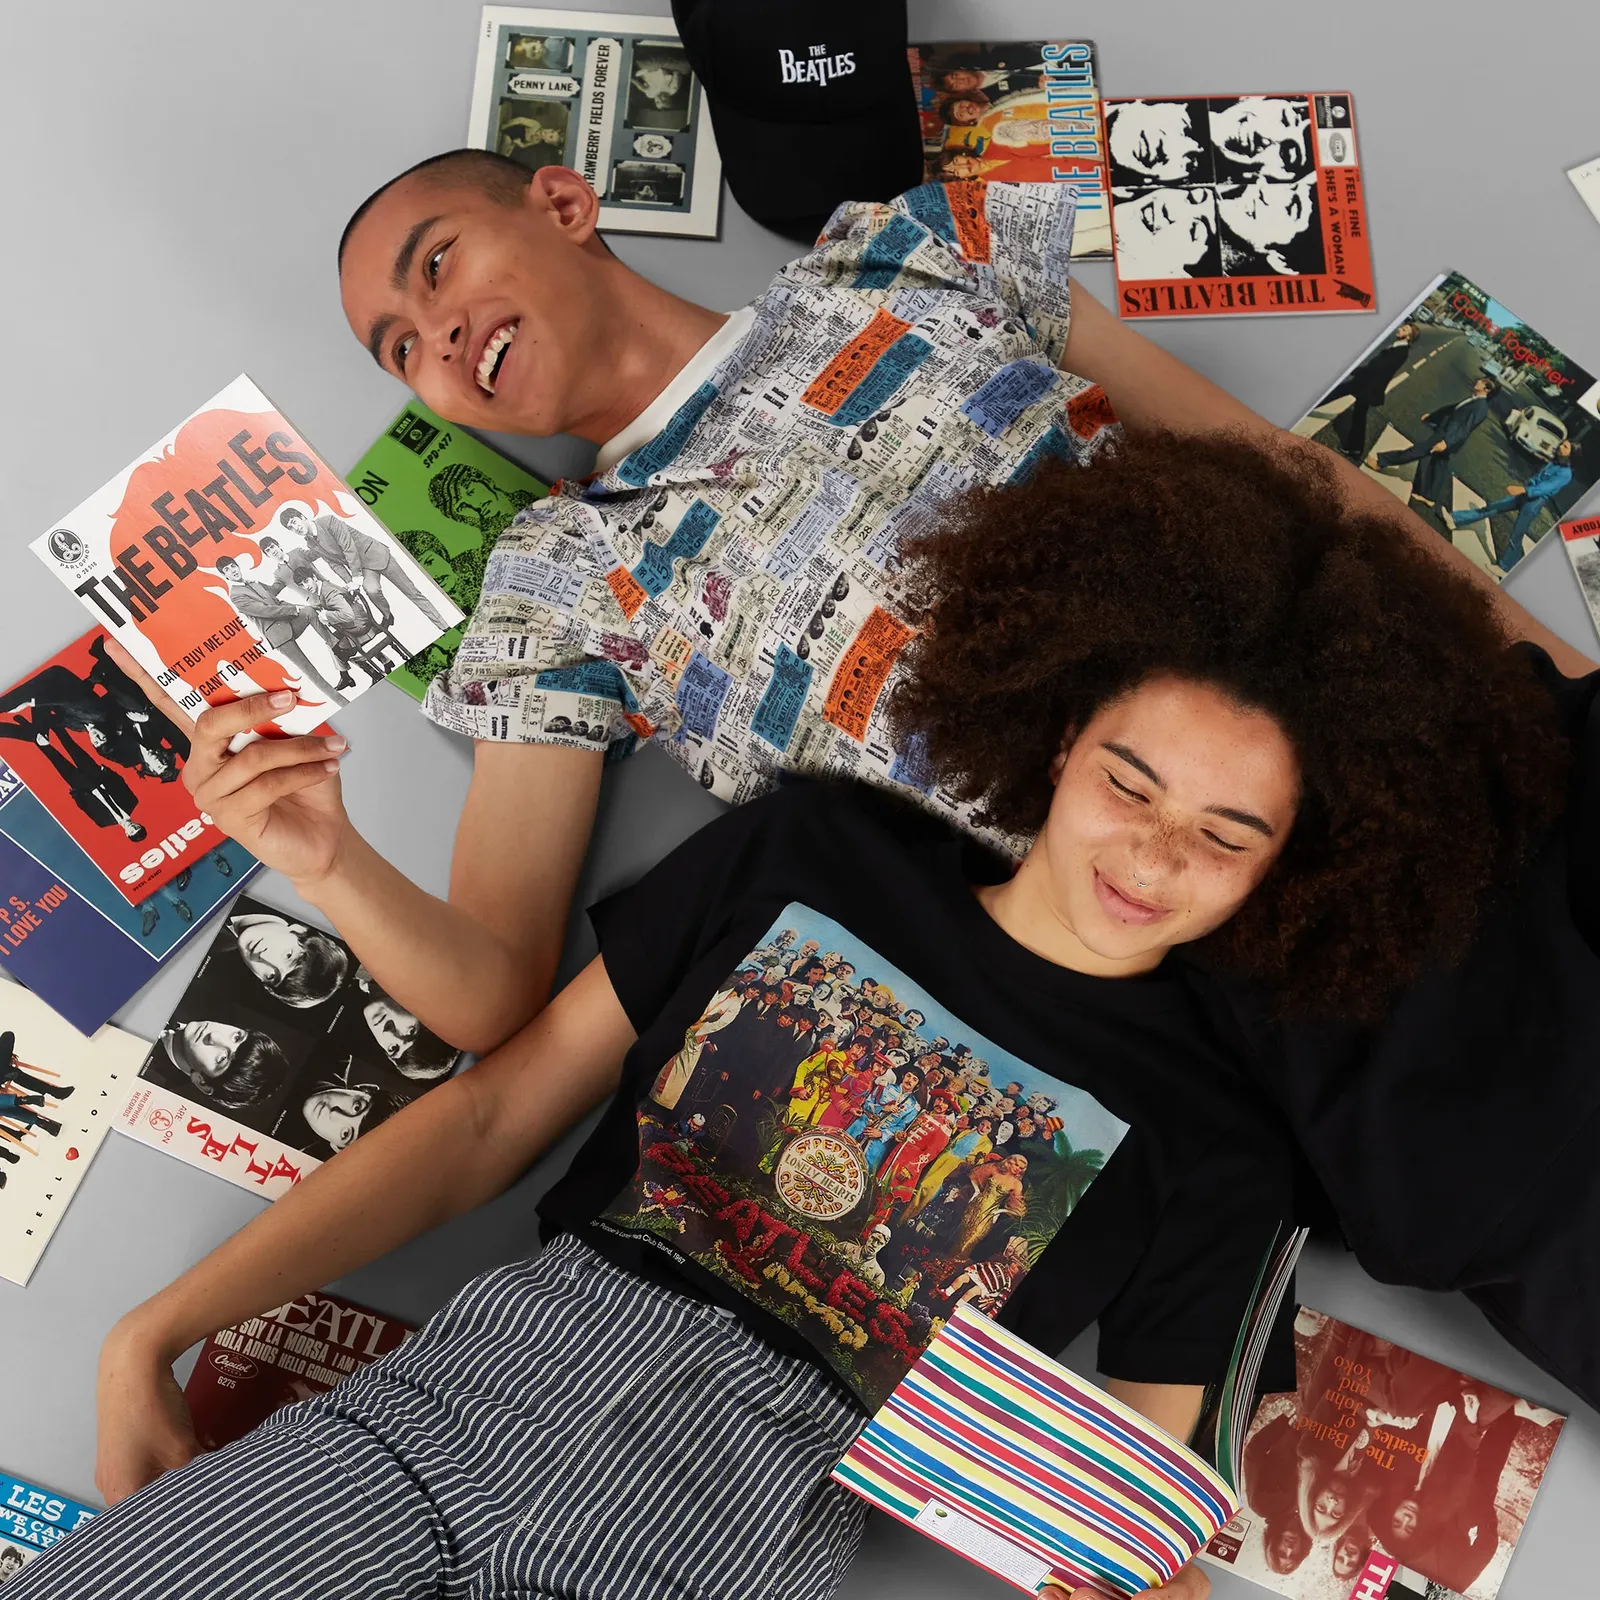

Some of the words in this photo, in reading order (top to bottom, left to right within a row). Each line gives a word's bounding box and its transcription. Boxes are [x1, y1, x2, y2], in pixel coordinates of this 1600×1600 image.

[808, 44, 827, 56] THE
[594, 44, 610, 88] FOREVER
[778, 49, 856, 86] BEATLES
[513, 80, 545, 90] PENNY
[548, 82, 573, 92] LANE
[1041, 43, 1098, 156] BEATLES
[590, 92, 605, 126] FIELDS
[1325, 169, 1338, 202] SHE'S
[1344, 176, 1356, 204] FEEL
[1329, 206, 1338, 216] A
[1349, 209, 1361, 238] FINE
[1331, 222, 1346, 275] WOMAN
[913, 294, 928, 310] 27
[1123, 282, 1256, 312] BEATLES
[1267, 279, 1325, 305] THE
[396, 418, 412, 434] EMI
[354, 470, 390, 506] ON
[74, 544, 174, 628] THE
[142, 428, 318, 580] BEATLES
[774, 517, 787, 531] 28
[858, 526, 872, 540] 28
[786, 550, 800, 564] 27
[157, 660, 186, 687] CAN'T
[183, 646, 206, 668] BUY
[203, 634, 224, 652] ME
[218, 616, 248, 641] LOVE
[178, 690, 202, 710] YOU
[200, 670, 229, 697] CAN'T
[226, 660, 244, 676] DO
[240, 640, 268, 664] THAT
[4, 910, 42, 948] LOVE
[35, 884, 68, 914] YOU
[122, 1092, 141, 1118] RECORDS
[128, 1090, 152, 1126] PARLOPHONE
[174, 1104, 188, 1121] ARE
[162, 1130, 174, 1144] ON
[186, 1116, 302, 1186] ATLES
[26, 1176, 62, 1236] REAL
[81, 1073, 118, 1134] LOVE
[812, 1138, 858, 1190] PEPPERS
[780, 1171, 802, 1204] CLUB
[802, 1200, 843, 1214] BAND
[784, 1154, 820, 1178] LONELY
[821, 1178, 857, 1202] HEARTS
[642, 1234, 657, 1246] Club
[656, 1242, 673, 1256] Band,
[672, 1252, 686, 1264] 1967
[260, 1294, 416, 1358] EATL
[214, 1330, 245, 1352] HOLA
[243, 1340, 279, 1364] ADIOS
[278, 1352, 305, 1374] HELLO
[305, 1363, 350, 1387] GOODBY
[240, 1318, 268, 1340] SOY
[266, 1324, 284, 1346] LA
[284, 1331, 330, 1363] MORSA
[332, 1352, 338, 1364] I
[337, 1354, 354, 1372] AM
[214, 1354, 253, 1374] Capitol
[1334, 1356, 1372, 1384] Yoko
[217, 1376, 238, 1390] 6275
[1338, 1377, 1370, 1396] and
[1325, 1388, 1364, 1416] John
[1296, 1416, 1350, 1450] Ballad
[1334, 1414, 1356, 1428] of
[1366, 1444, 1396, 1472] The
[1372, 1428, 1428, 1464] Beatles
[0, 1507, 28, 1526] WE
[7, 1484, 66, 1522] LES
[11, 1524, 54, 1548] DAY
